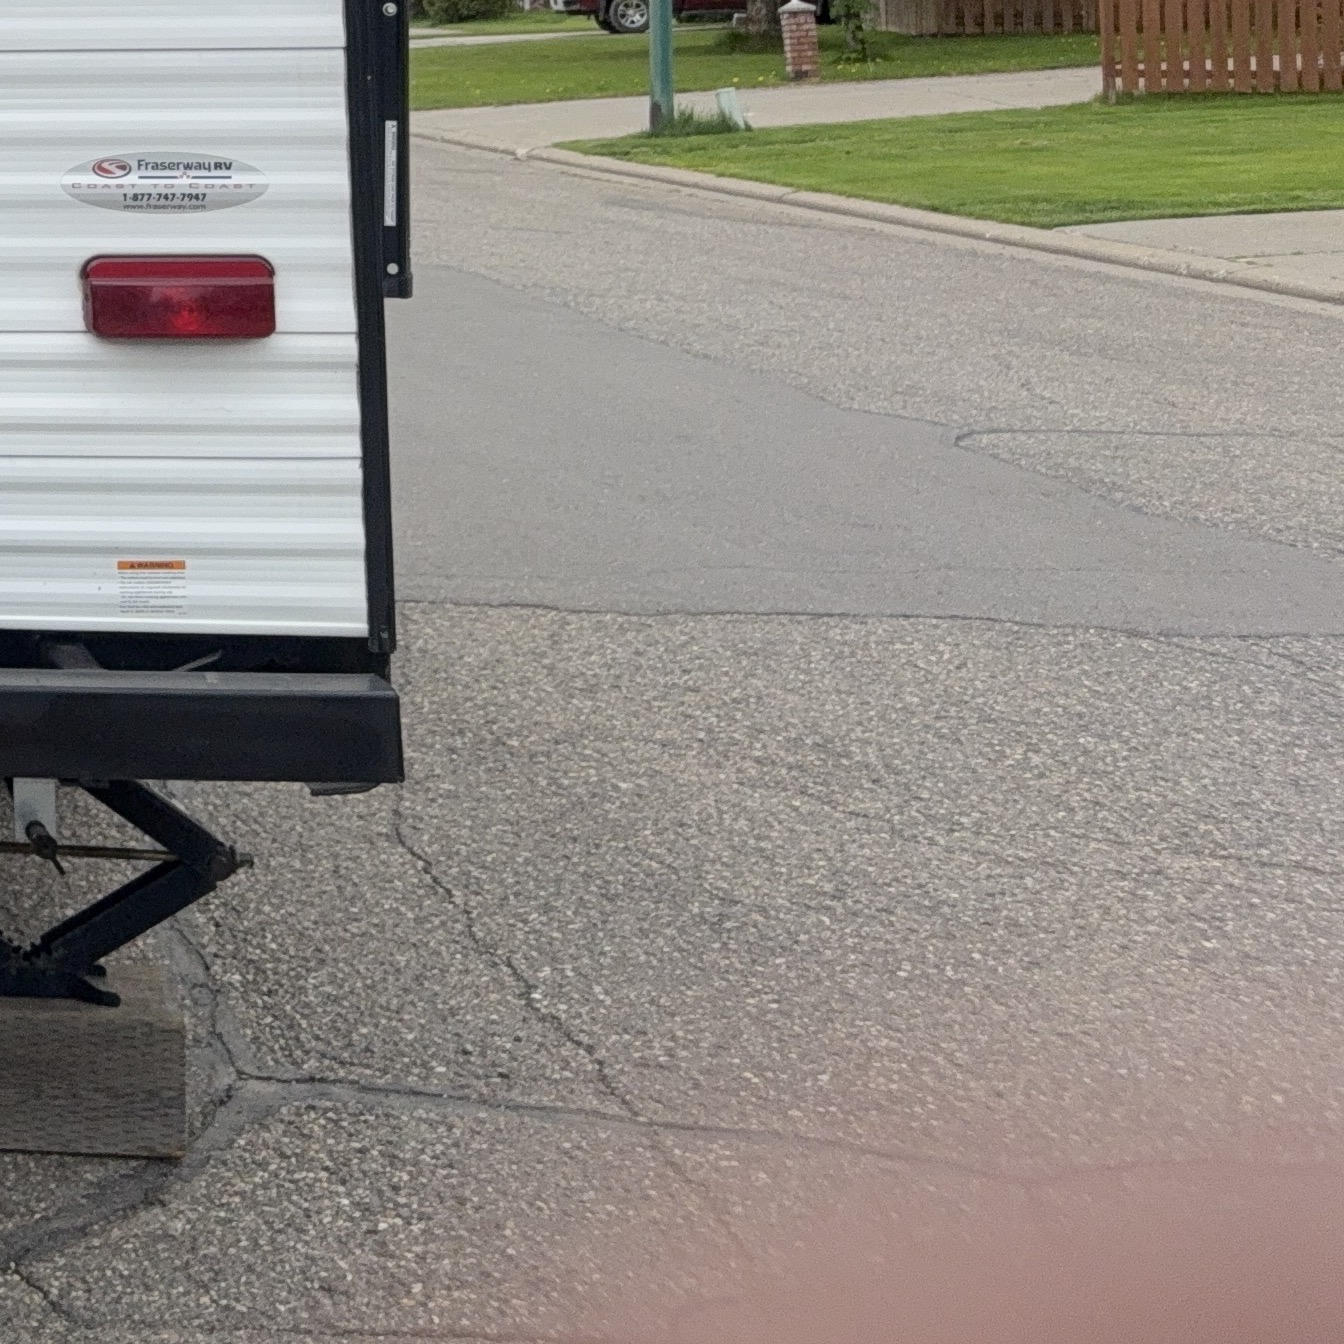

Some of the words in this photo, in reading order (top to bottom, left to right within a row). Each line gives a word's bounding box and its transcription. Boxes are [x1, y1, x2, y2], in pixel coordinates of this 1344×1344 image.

[137, 159, 211, 172] Fraserway
[214, 161, 233, 171] RV
[122, 193, 207, 202] 1-877-747-7947
